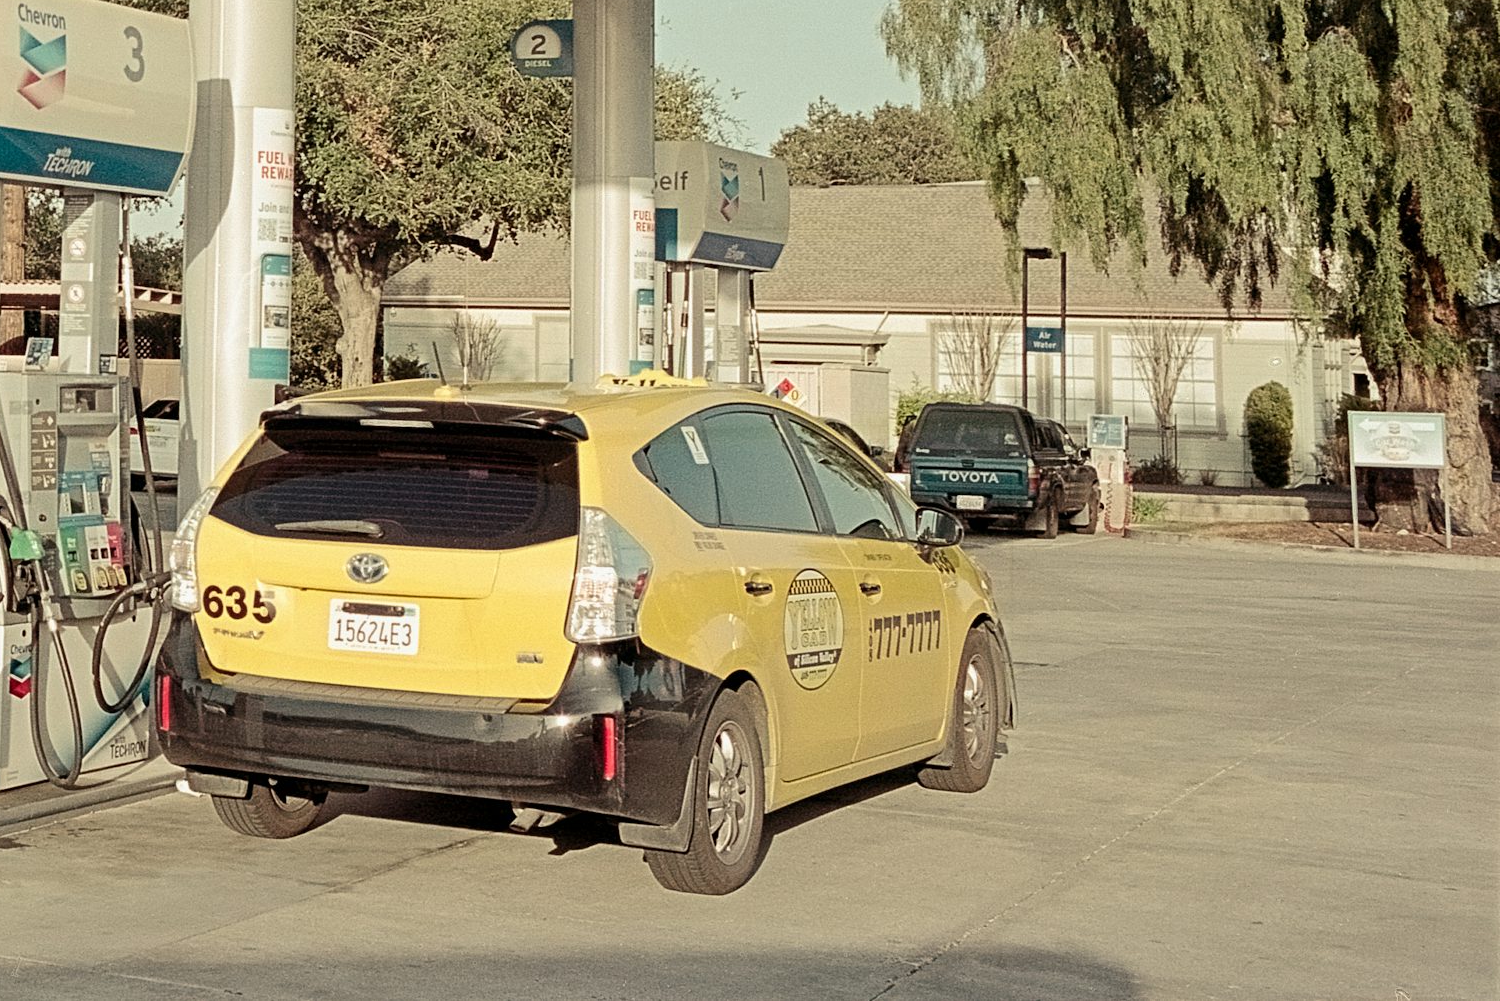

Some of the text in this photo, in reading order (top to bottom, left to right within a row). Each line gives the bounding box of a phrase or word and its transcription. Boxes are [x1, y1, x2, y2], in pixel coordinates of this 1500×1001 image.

[17, 3, 66, 30] Chevron
[531, 34, 547, 55] 2
[123, 26, 146, 82] 3
[56, 146, 71, 159] with
[257, 150, 286, 165] FUEL
[42, 153, 95, 178] TECHRON
[758, 166, 765, 202] 1
[258, 202, 277, 213] Join
[633, 210, 653, 221] FUEL
[1038, 331, 1052, 340] Air
[1033, 341, 1057, 349] Water
[774, 389, 780, 399] 1
[784, 382, 790, 392] 3
[791, 390, 799, 401] 0
[939, 470, 999, 484] TOYOTA
[203, 585, 276, 624] 635
[787, 597, 837, 650] YELLOW
[334, 619, 412, 646] 15624E3
[800, 631, 828, 648] CAB
[874, 610, 940, 660] 777-7777
[110, 740, 147, 759] TECHRON
